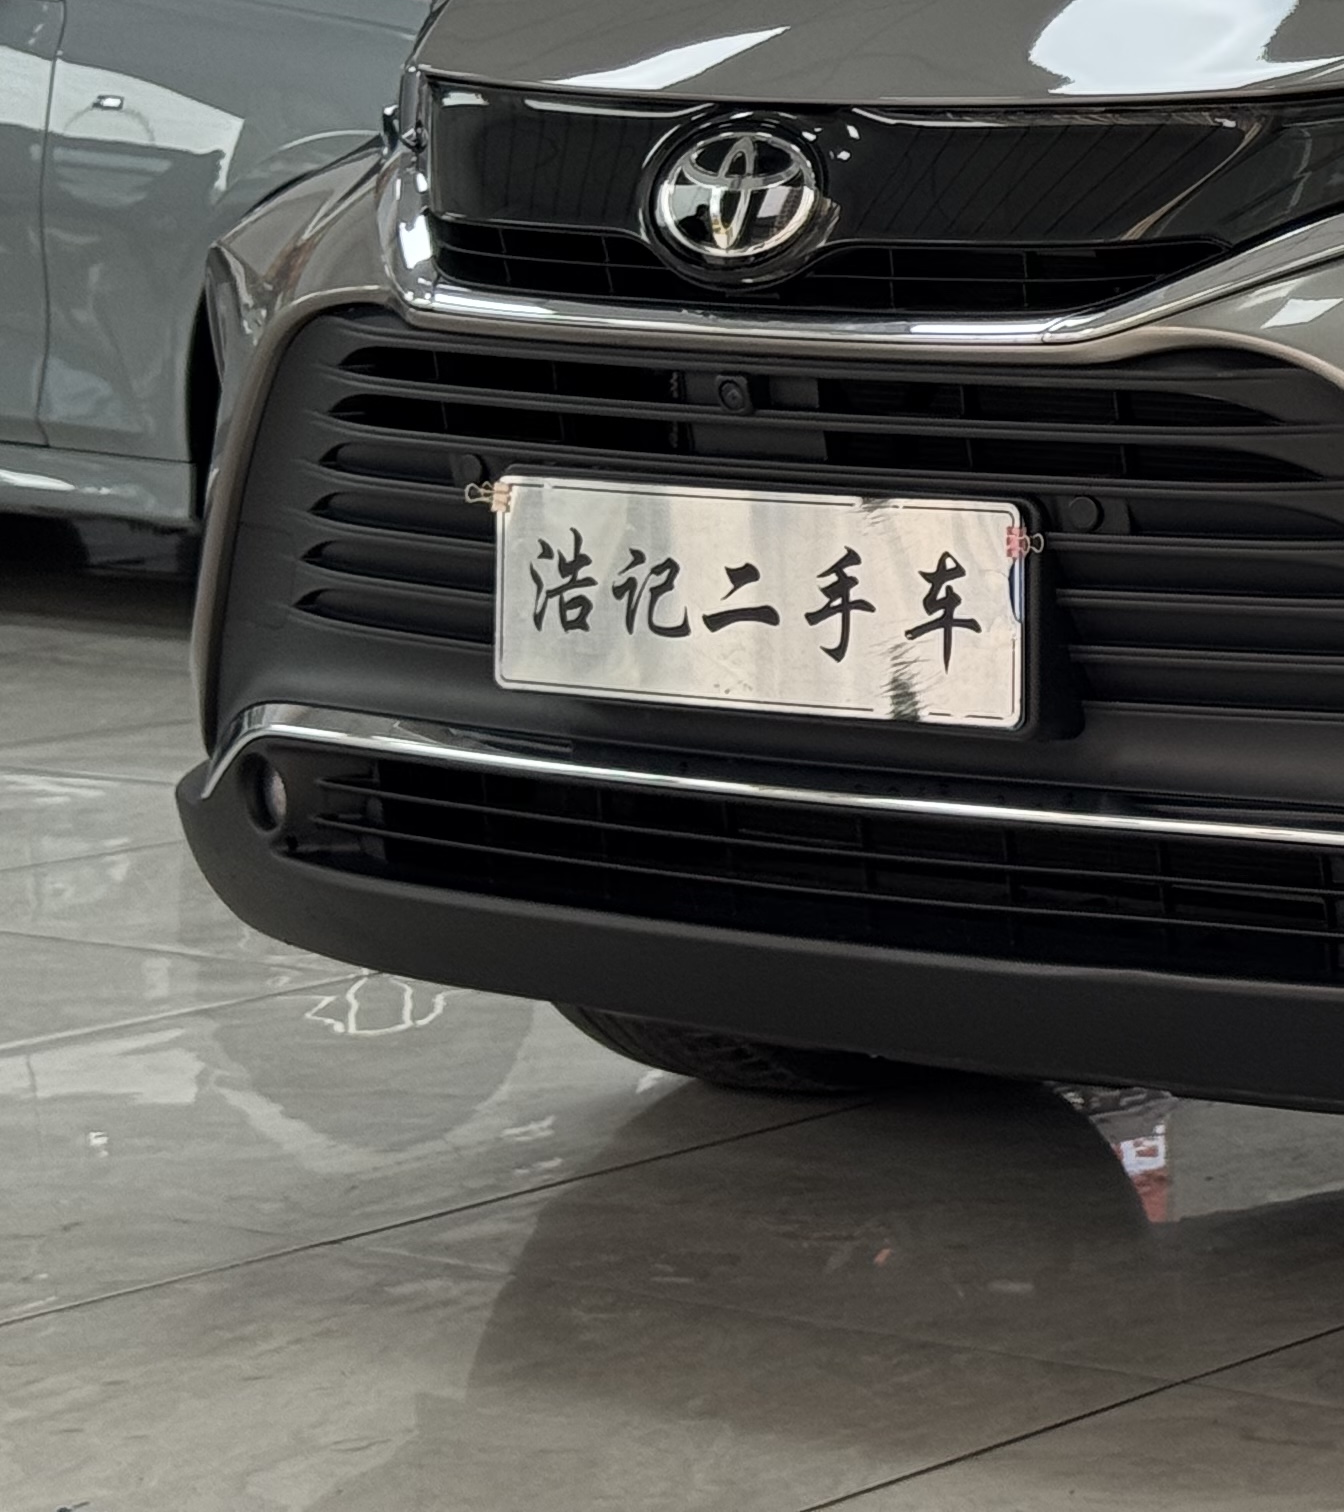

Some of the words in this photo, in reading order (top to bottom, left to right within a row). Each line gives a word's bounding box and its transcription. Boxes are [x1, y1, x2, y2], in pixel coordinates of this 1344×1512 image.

[529, 526, 982, 675] 浩记二手车
